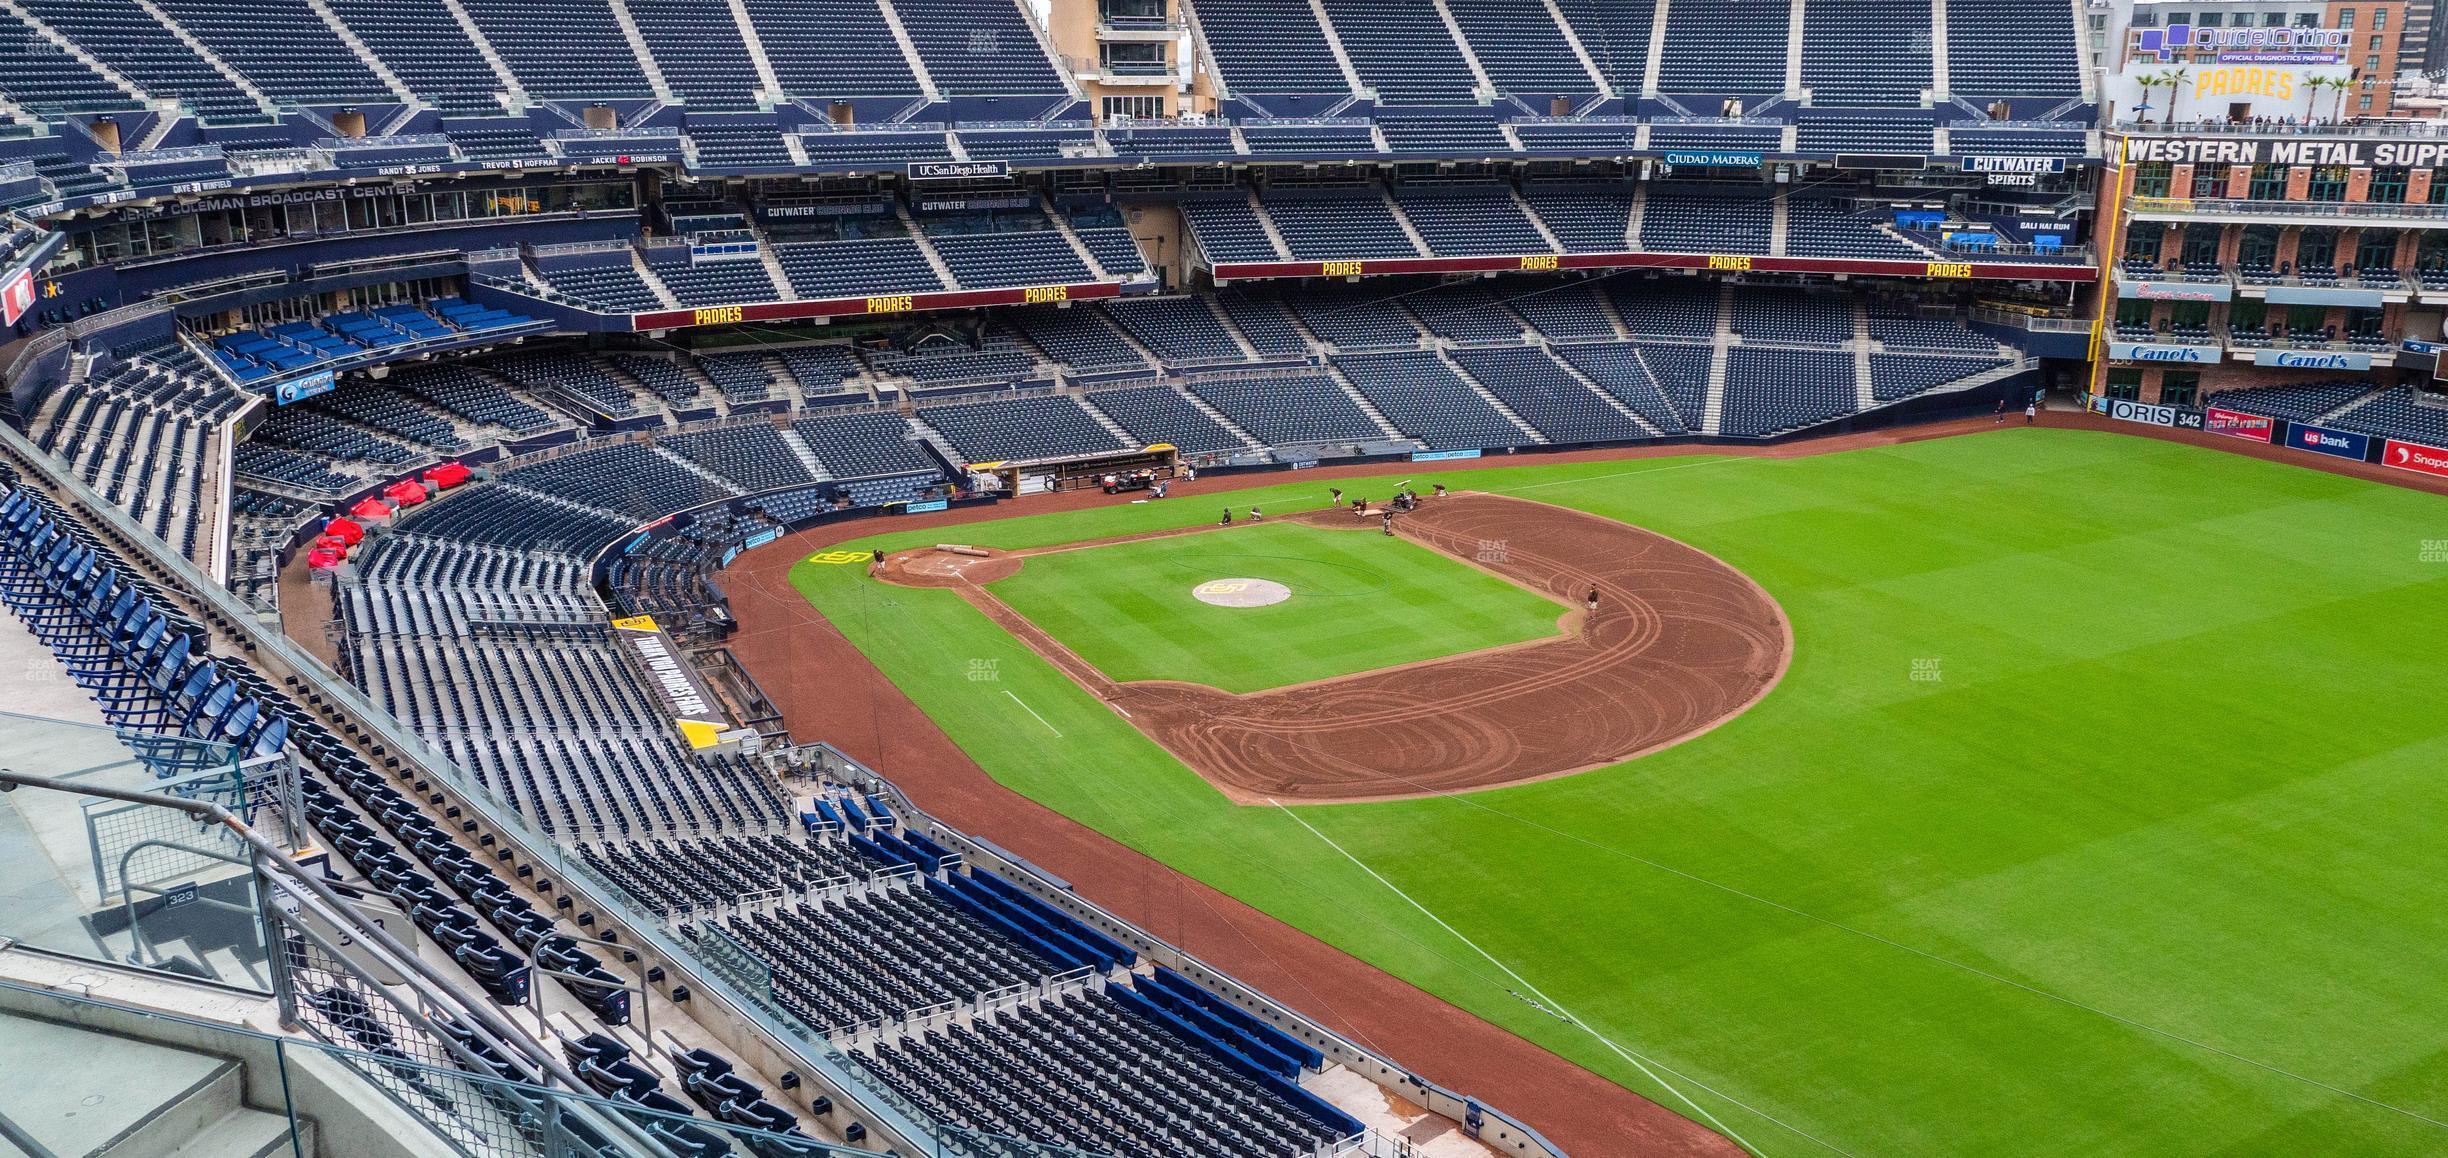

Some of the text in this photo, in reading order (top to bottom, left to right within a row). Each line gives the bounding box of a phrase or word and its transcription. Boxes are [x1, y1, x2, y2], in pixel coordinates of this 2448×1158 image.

[2195, 26, 2343, 51] QuidelOrtho
[2222, 54, 2335, 62] OFFICIAL DIAGNOSTICS PARTNER
[2194, 66, 2294, 101] PADRES
[591, 154, 668, 165] JACKIE 42 ROBINSON
[1667, 153, 1760, 166] CIUDAD MADERAS
[2127, 139, 2257, 164] WESTERN
[2271, 142, 2365, 166] METAL
[378, 163, 441, 176] RANDY 35 JONES
[481, 158, 558, 170] TREVOR 51 HOFFMAN
[919, 163, 999, 177] UC San Diego Health
[1973, 157, 2053, 172] CUTWATER
[1987, 173, 2036, 186] SPIRITS
[119, 183, 416, 222] JERRY COLEMAN BROADCAST CENTER
[922, 200, 966, 211] CUTWATER
[768, 206, 815, 217] CUTWATER
[2020, 222, 2038, 230] BALI
[1322, 262, 1362, 277] PADRES
[1520, 255, 1558, 270] PADRES
[1708, 255, 1751, 271] PADRES
[1926, 263, 1972, 278] PADRES
[1025, 286, 1067, 302] PADRES
[867, 296, 913, 313] PADRES
[695, 306, 742, 325] PADRES
[2131, 345, 2199, 362] Canel's
[2277, 352, 2348, 369] Canel's
[2115, 403, 2172, 425] ORIS
[2179, 413, 2201, 428] 342
[1447, 451, 1463, 459] petco
[907, 504, 927, 512] petco
[169, 890, 194, 905] 323
